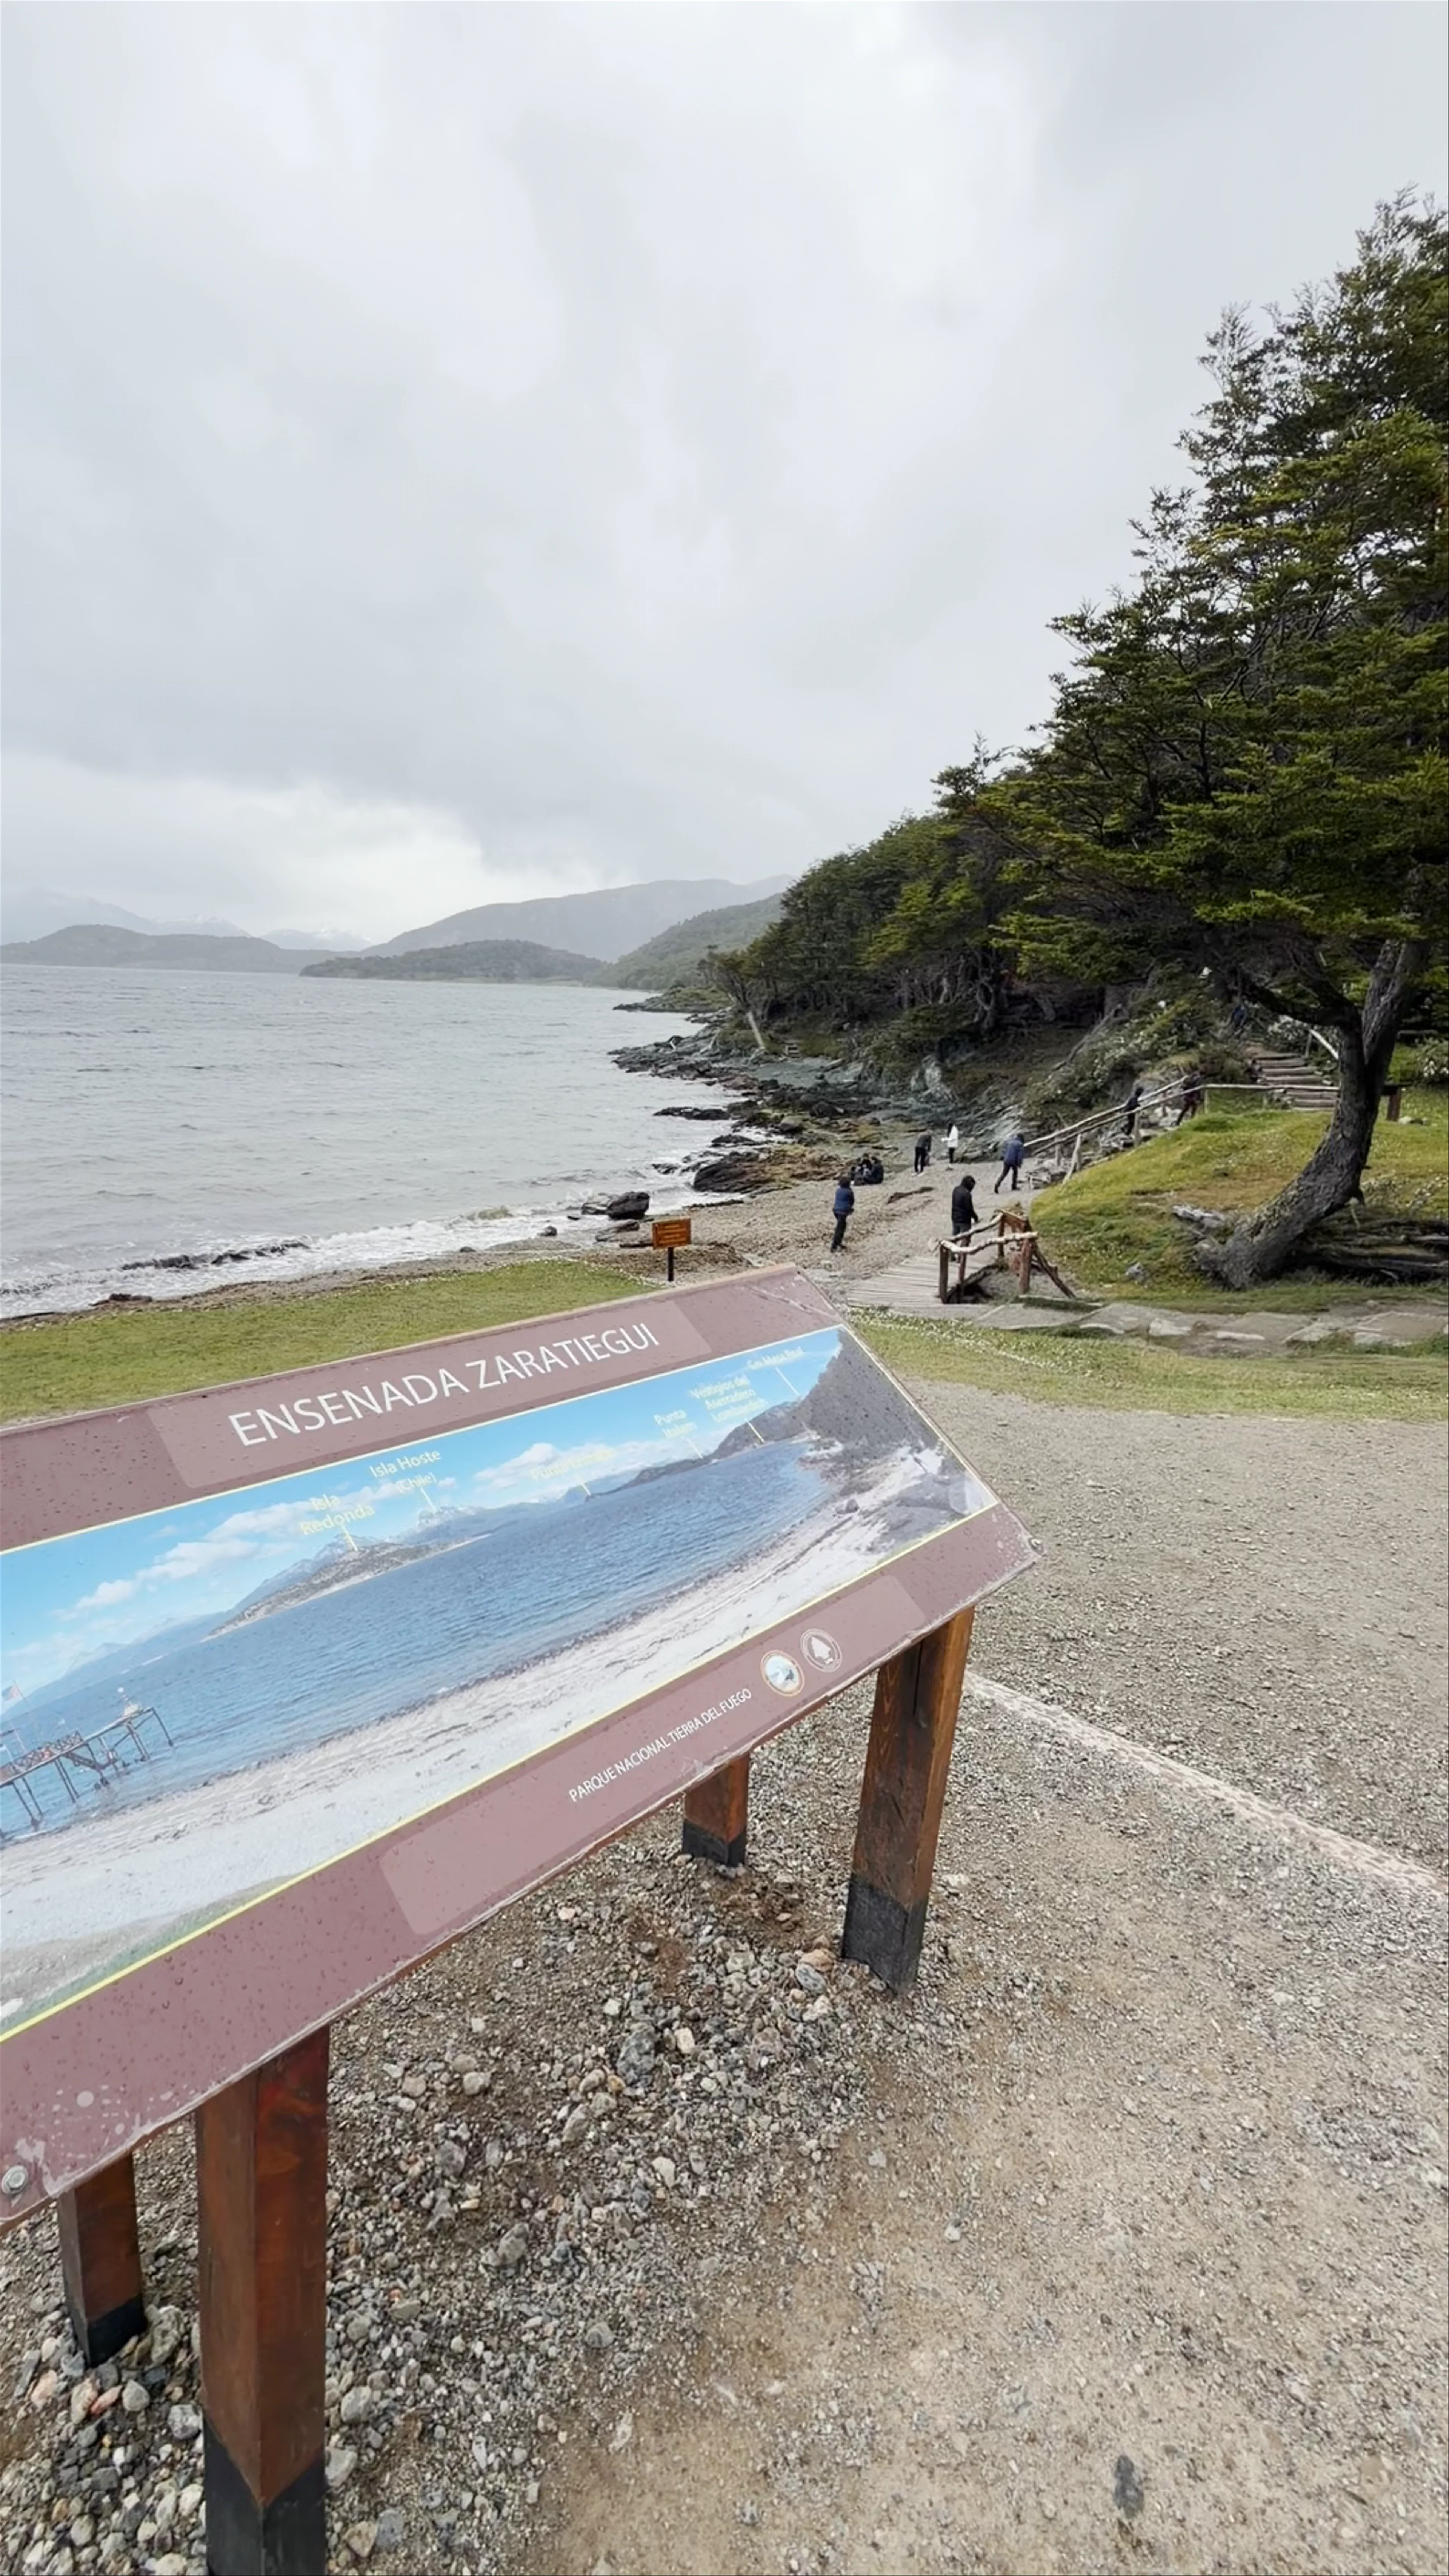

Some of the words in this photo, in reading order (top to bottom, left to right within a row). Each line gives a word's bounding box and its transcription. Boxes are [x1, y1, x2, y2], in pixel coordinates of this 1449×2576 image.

[228, 1367, 470, 1447] ENSENADA
[465, 1323, 660, 1389] ZARATIEGUI
[369, 1462, 397, 1478] Isla
[397, 1450, 441, 1470] Hoste
[397, 1472, 437, 1493] (Chile)
[311, 1493, 340, 1511] Isla
[299, 1503, 375, 1535] Redonda
[569, 1766, 617, 1802] PARQUE
[614, 1736, 671, 1775] NACIONAL
[667, 1717, 704, 1743] TIERRA
[701, 1707, 722, 1724] DEL
[719, 1688, 752, 1713] FUEGO
